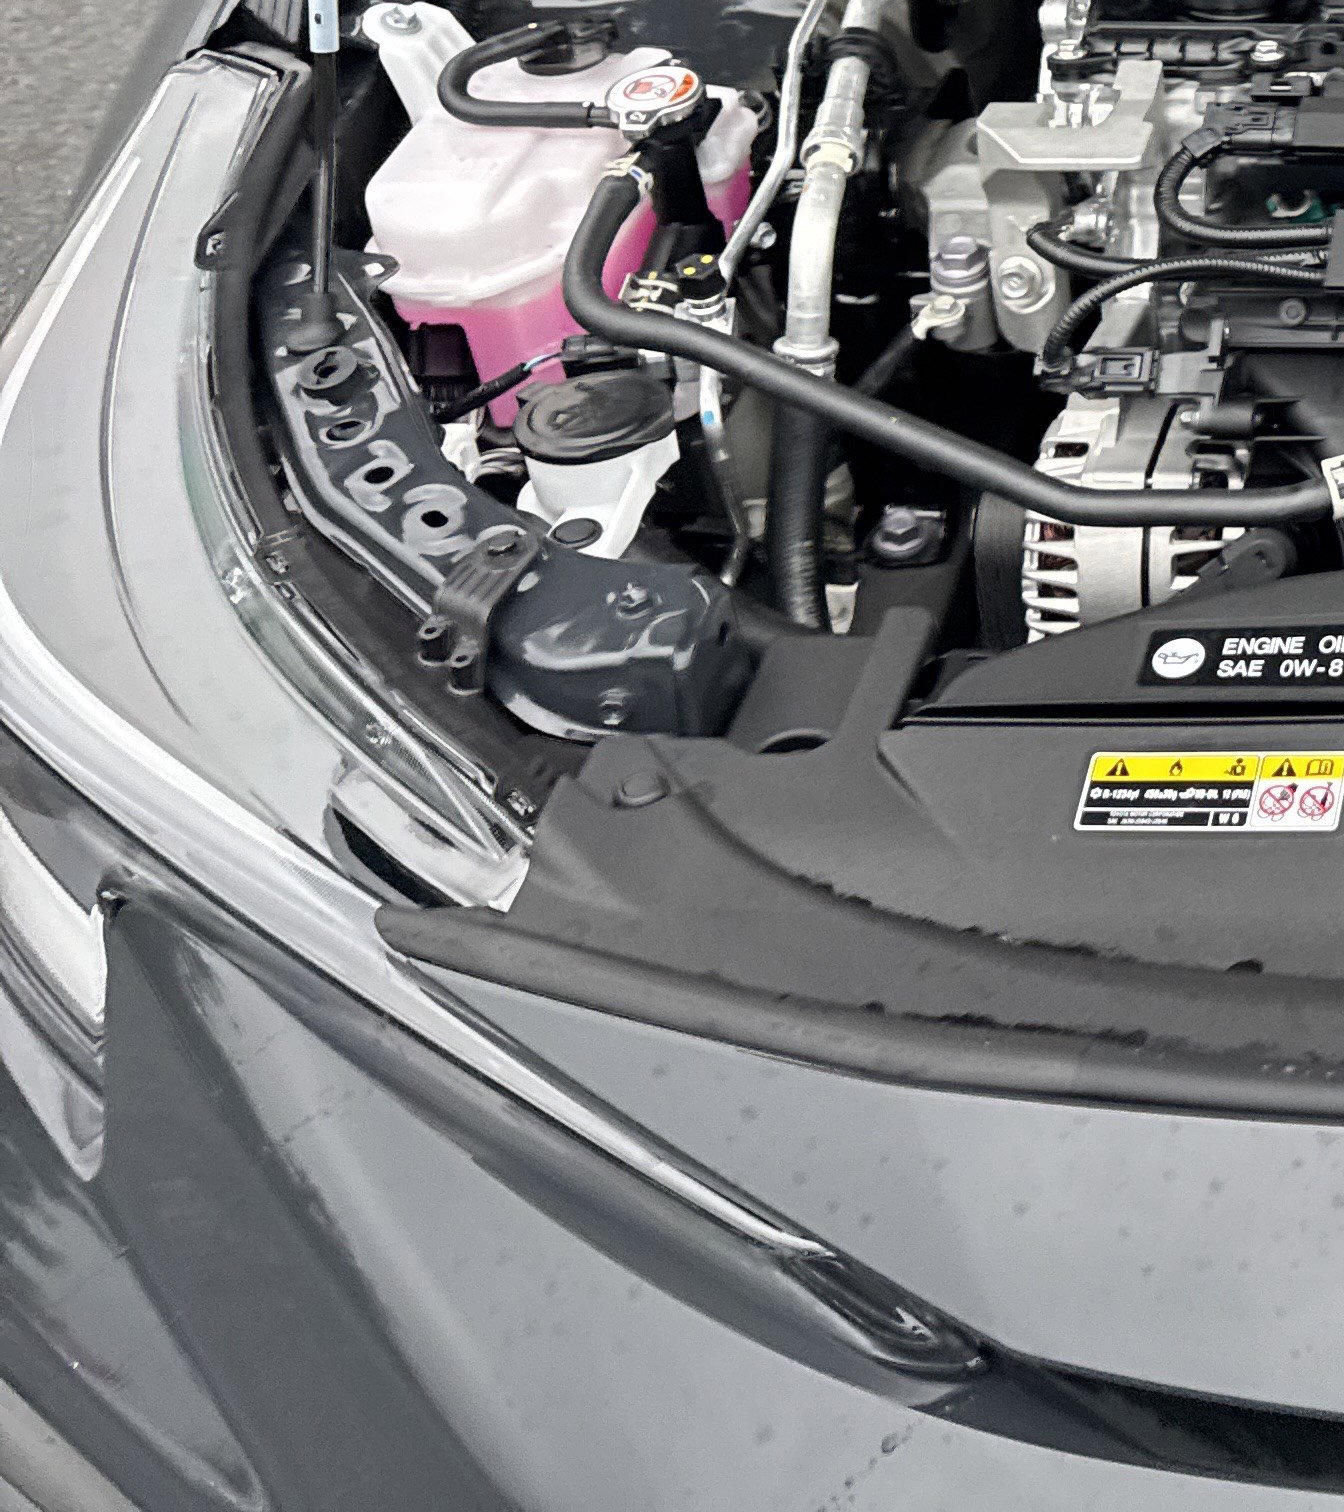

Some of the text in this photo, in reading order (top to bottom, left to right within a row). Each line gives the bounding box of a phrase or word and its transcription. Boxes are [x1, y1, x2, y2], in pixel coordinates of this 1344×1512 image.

[1221, 636, 1306, 655] ENGINE
[1216, 658, 1344, 678] SAE 0W-8
